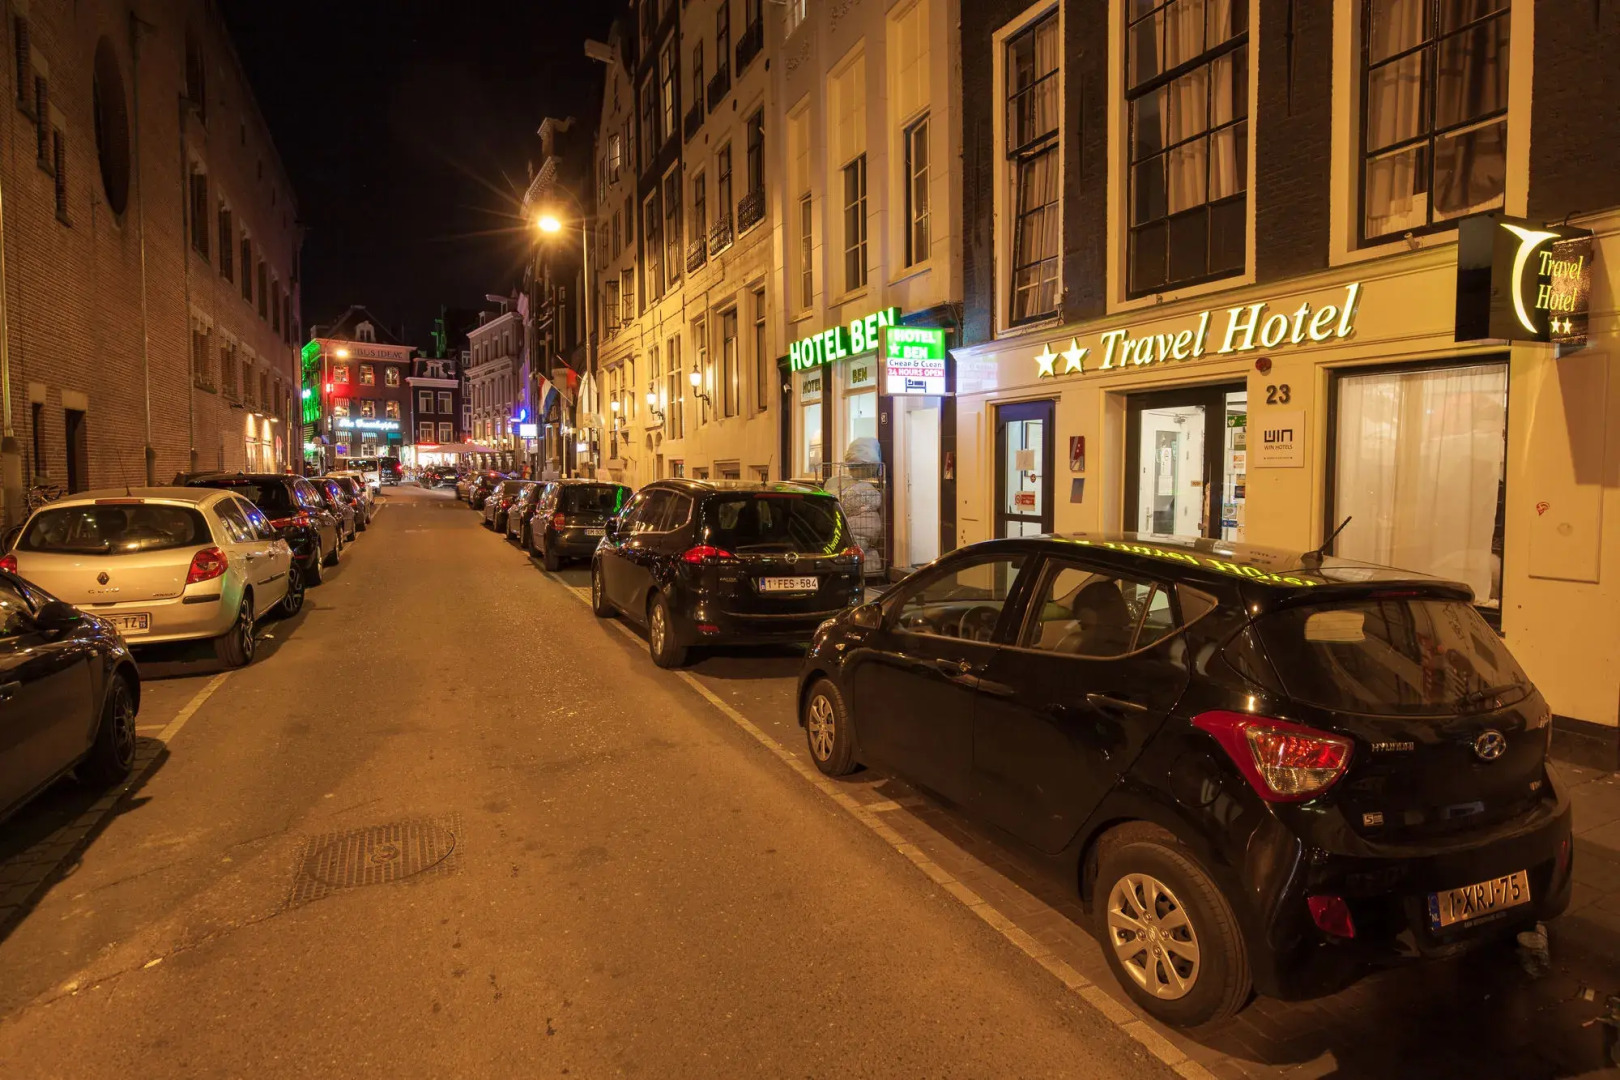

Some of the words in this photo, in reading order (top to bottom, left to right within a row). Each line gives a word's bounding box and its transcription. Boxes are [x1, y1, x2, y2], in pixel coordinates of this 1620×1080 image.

[1538, 251, 1584, 279] Travel
[1536, 284, 1577, 312] Hotel
[789, 326, 846, 371] HOTEL
[850, 307, 895, 354] BEN
[894, 329, 936, 343] HOTEL
[1099, 311, 1209, 370] Travel
[1217, 283, 1361, 354] Hotel
[904, 345, 928, 359] BEN
[803, 379, 821, 394] HOTEL
[852, 366, 867, 384] BEN
[924, 369, 944, 377] OPEN
[1266, 384, 1291, 405] 23
[1450, 875, 1520, 918] 1-XRJ-75
